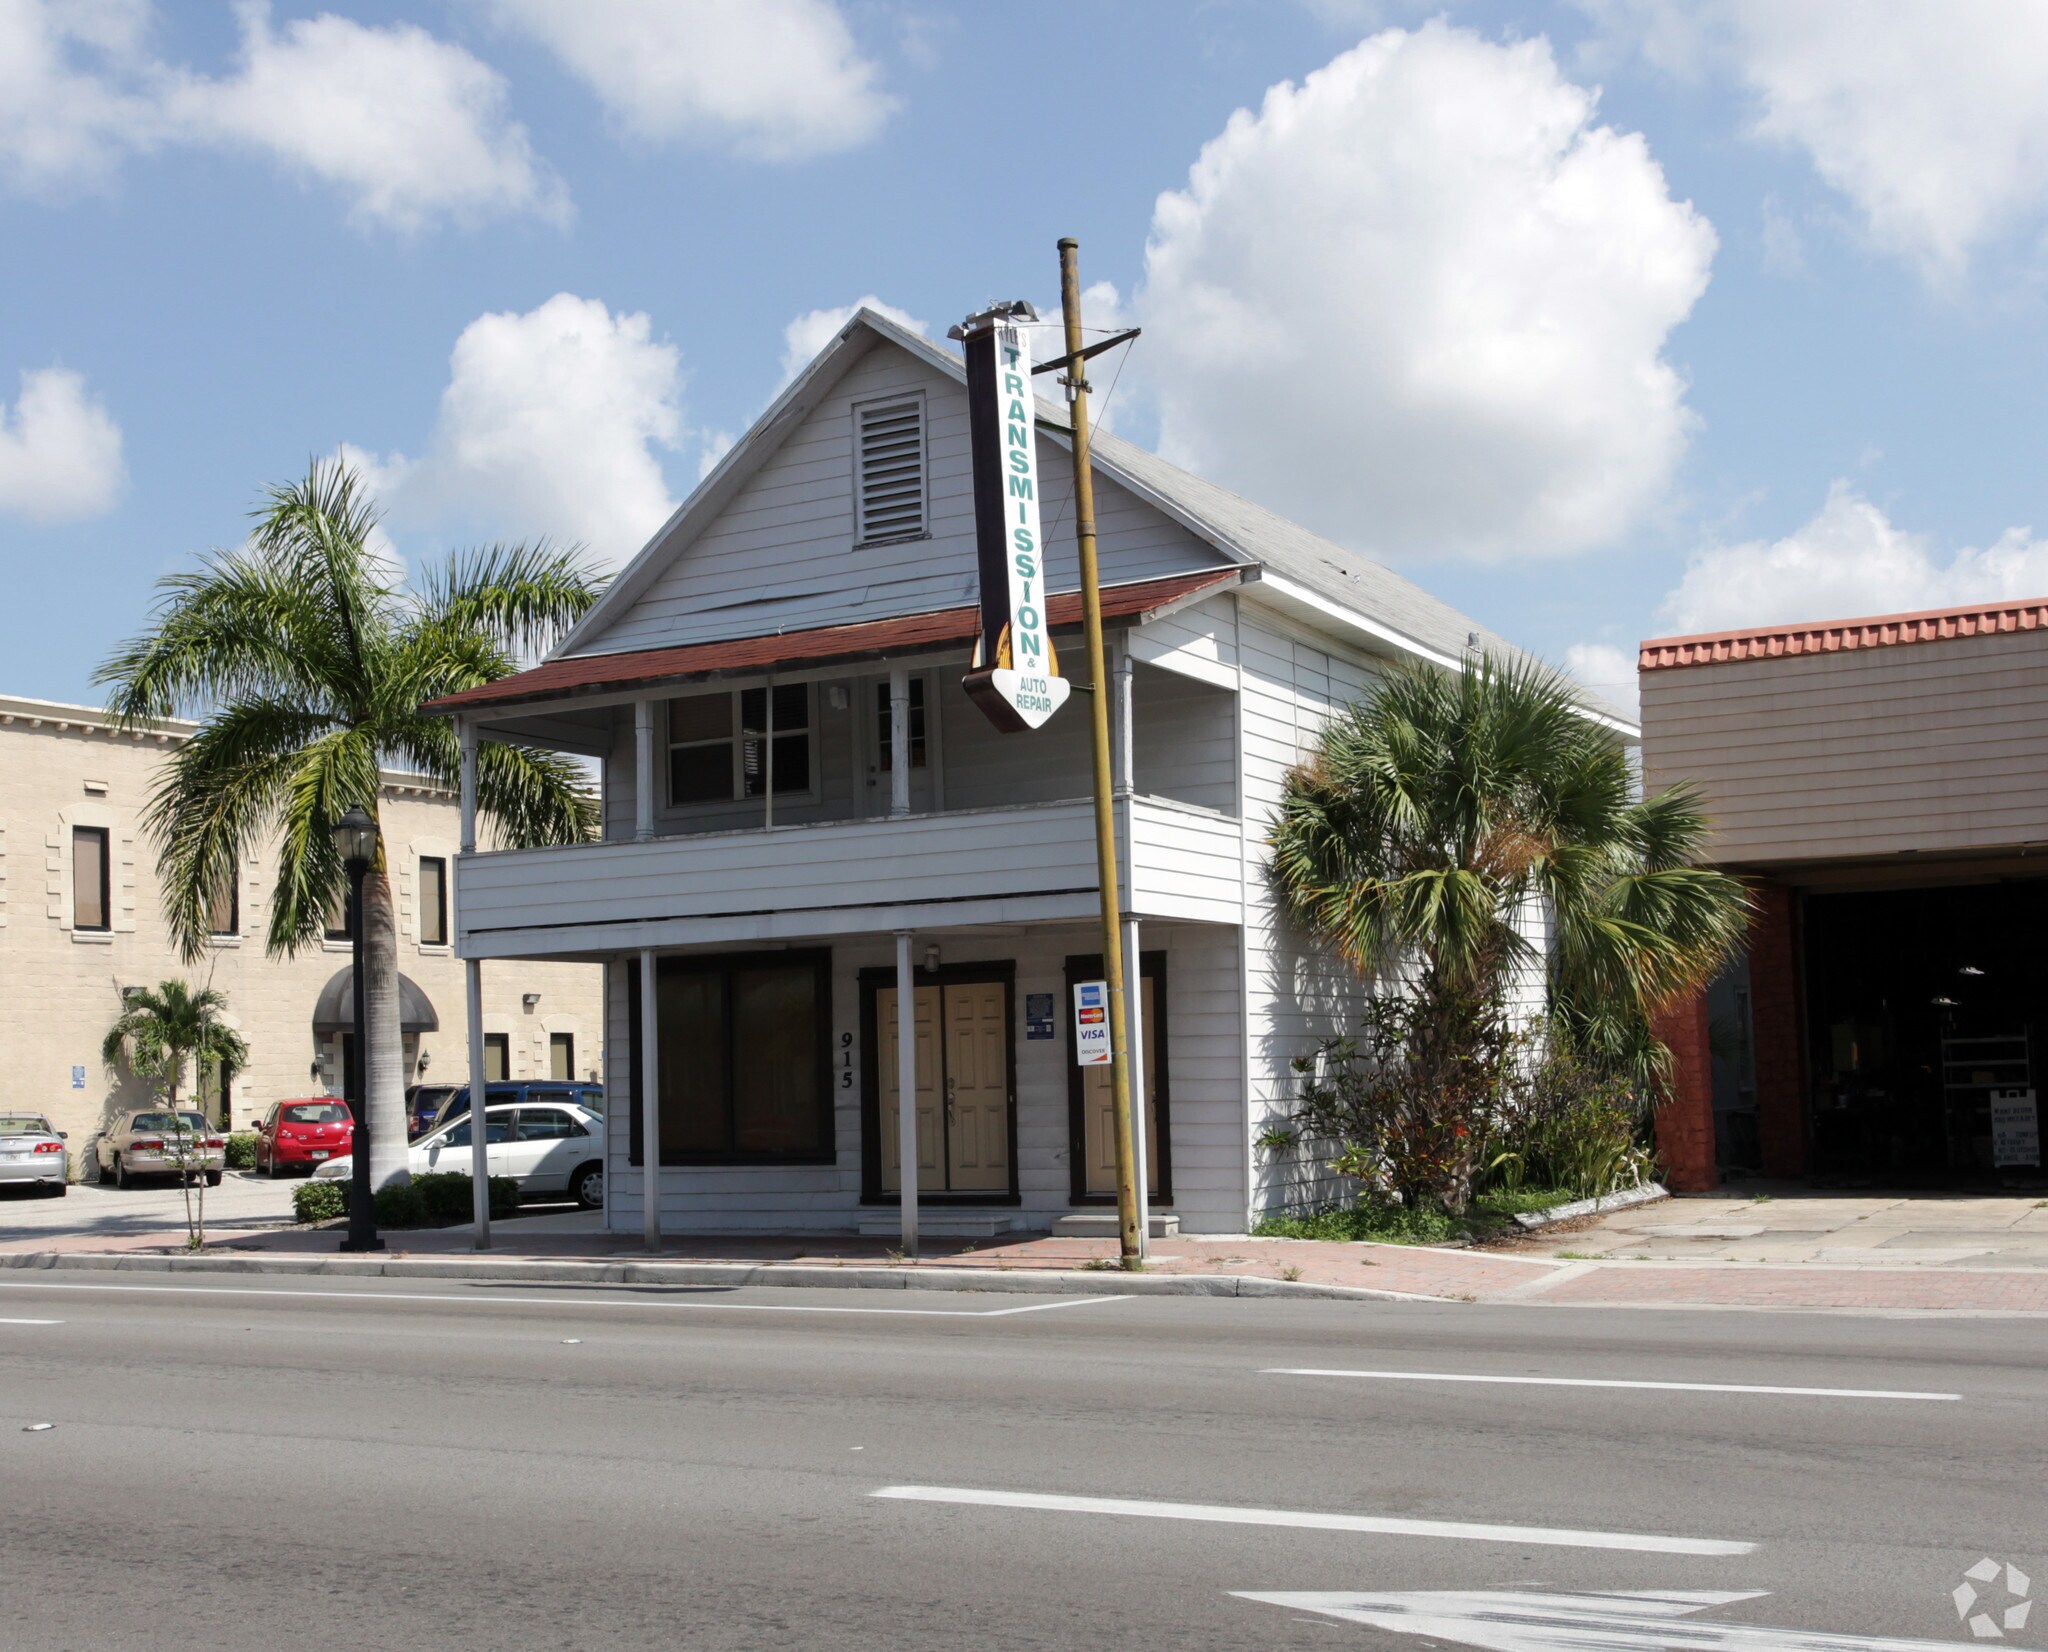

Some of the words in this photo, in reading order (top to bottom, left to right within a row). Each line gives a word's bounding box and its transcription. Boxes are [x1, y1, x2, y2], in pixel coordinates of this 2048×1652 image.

[1004, 347, 1041, 656] TRANSMISSION
[1027, 658, 1036, 668] &
[1020, 677, 1047, 694] AUTO
[1016, 694, 1052, 713] REPAIR
[1080, 1030, 1104, 1039] VISA
[841, 1032, 853, 1089] 915
